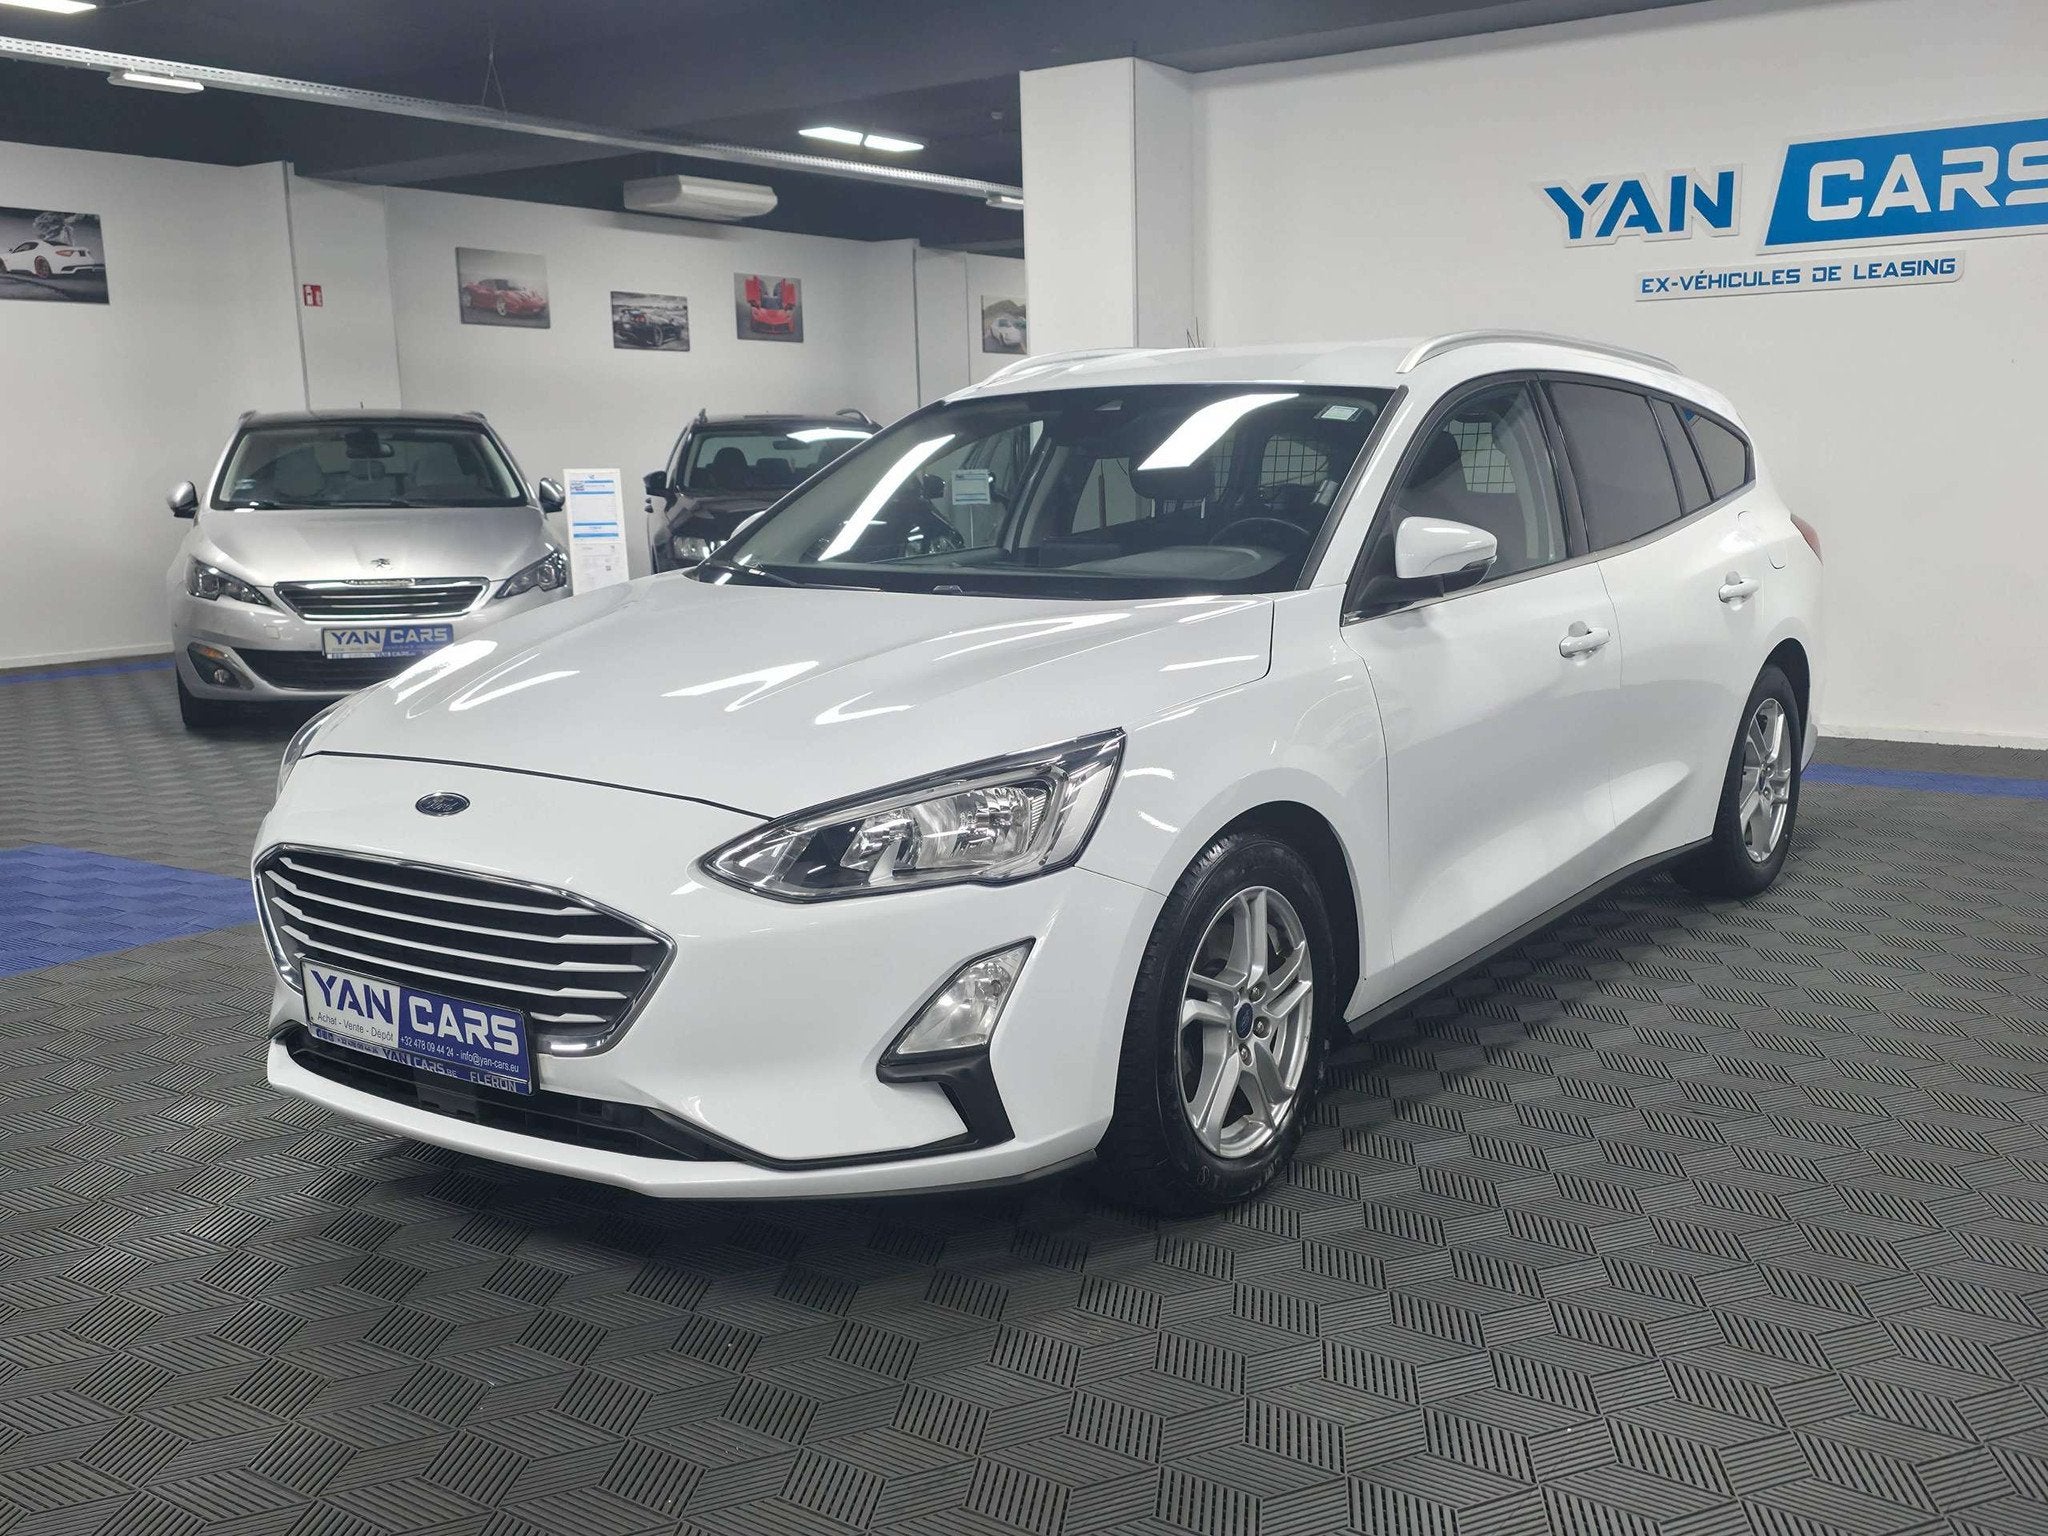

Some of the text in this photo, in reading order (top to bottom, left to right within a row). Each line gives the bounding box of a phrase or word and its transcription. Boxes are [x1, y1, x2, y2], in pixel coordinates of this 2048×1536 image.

[1544, 141, 2048, 239] YAN CARS
[1641, 257, 1956, 293] EX-VÉHICULES DE LEASING
[331, 628, 449, 645] YAN CARS
[311, 970, 394, 1025] YAN
[408, 995, 520, 1056] CARS
[318, 1012, 337, 1026] Achat
[344, 1019, 364, 1034] Vente
[401, 1036, 413, 1047] +32
[461, 1050, 519, 1073] info@yan-cars.eu
[470, 1071, 517, 1093] FLERON
